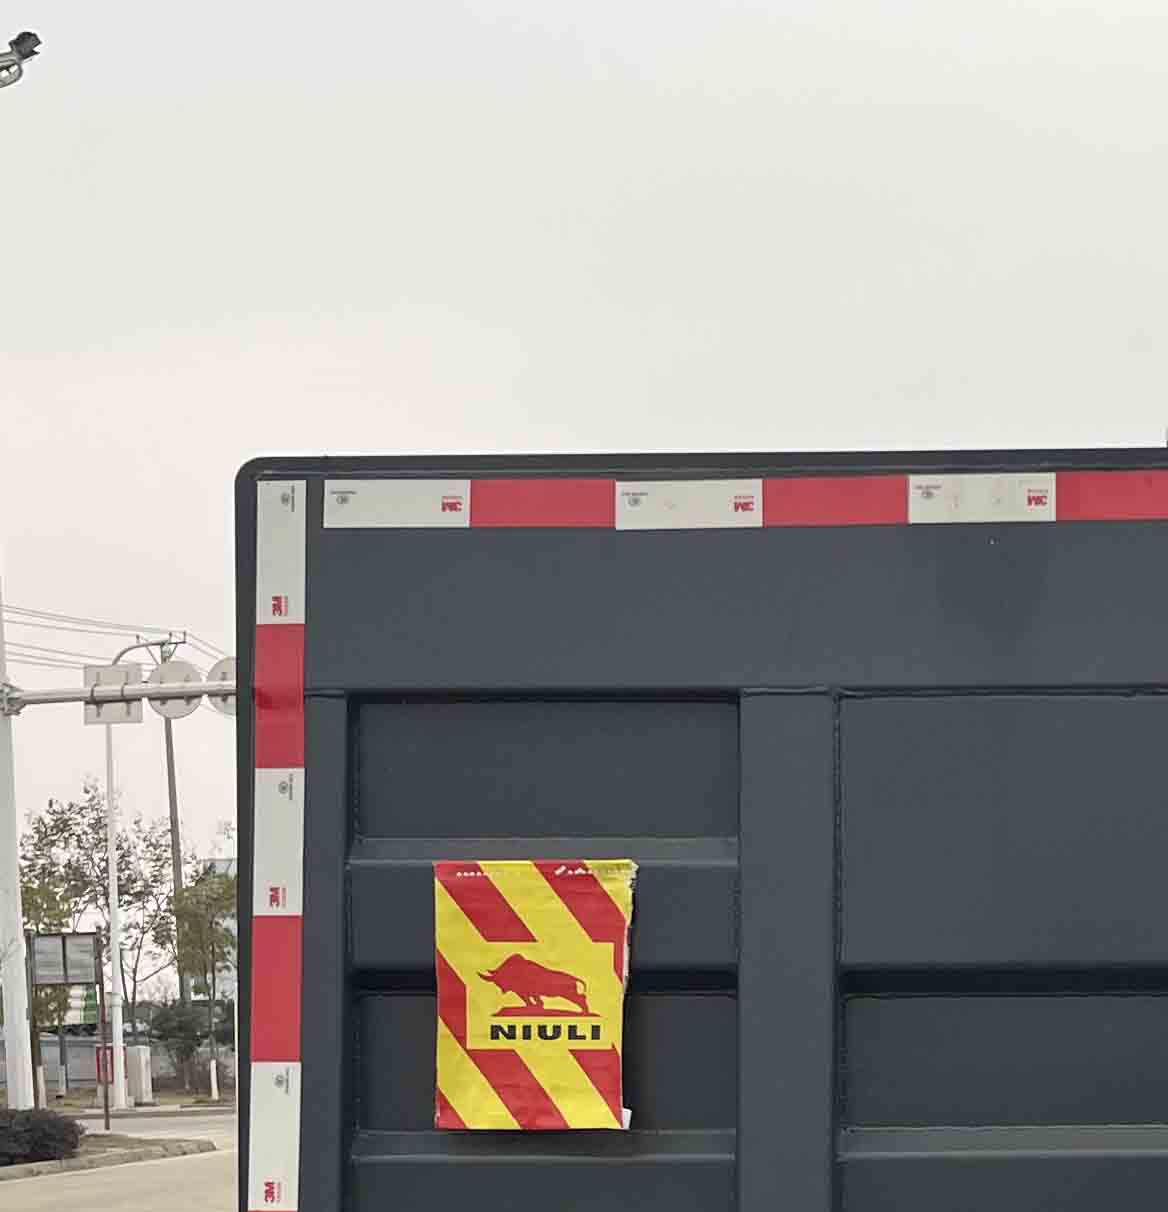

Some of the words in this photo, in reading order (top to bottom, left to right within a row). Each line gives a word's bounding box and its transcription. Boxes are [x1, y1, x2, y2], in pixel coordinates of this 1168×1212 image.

[441, 501, 462, 512] 3M
[734, 501, 754, 512] 3M
[1027, 495, 1047, 506] 3M
[271, 595, 282, 616] 3M
[270, 887, 280, 907] 3M
[490, 1024, 601, 1041] NIULI
[264, 1181, 275, 1203] 3M
